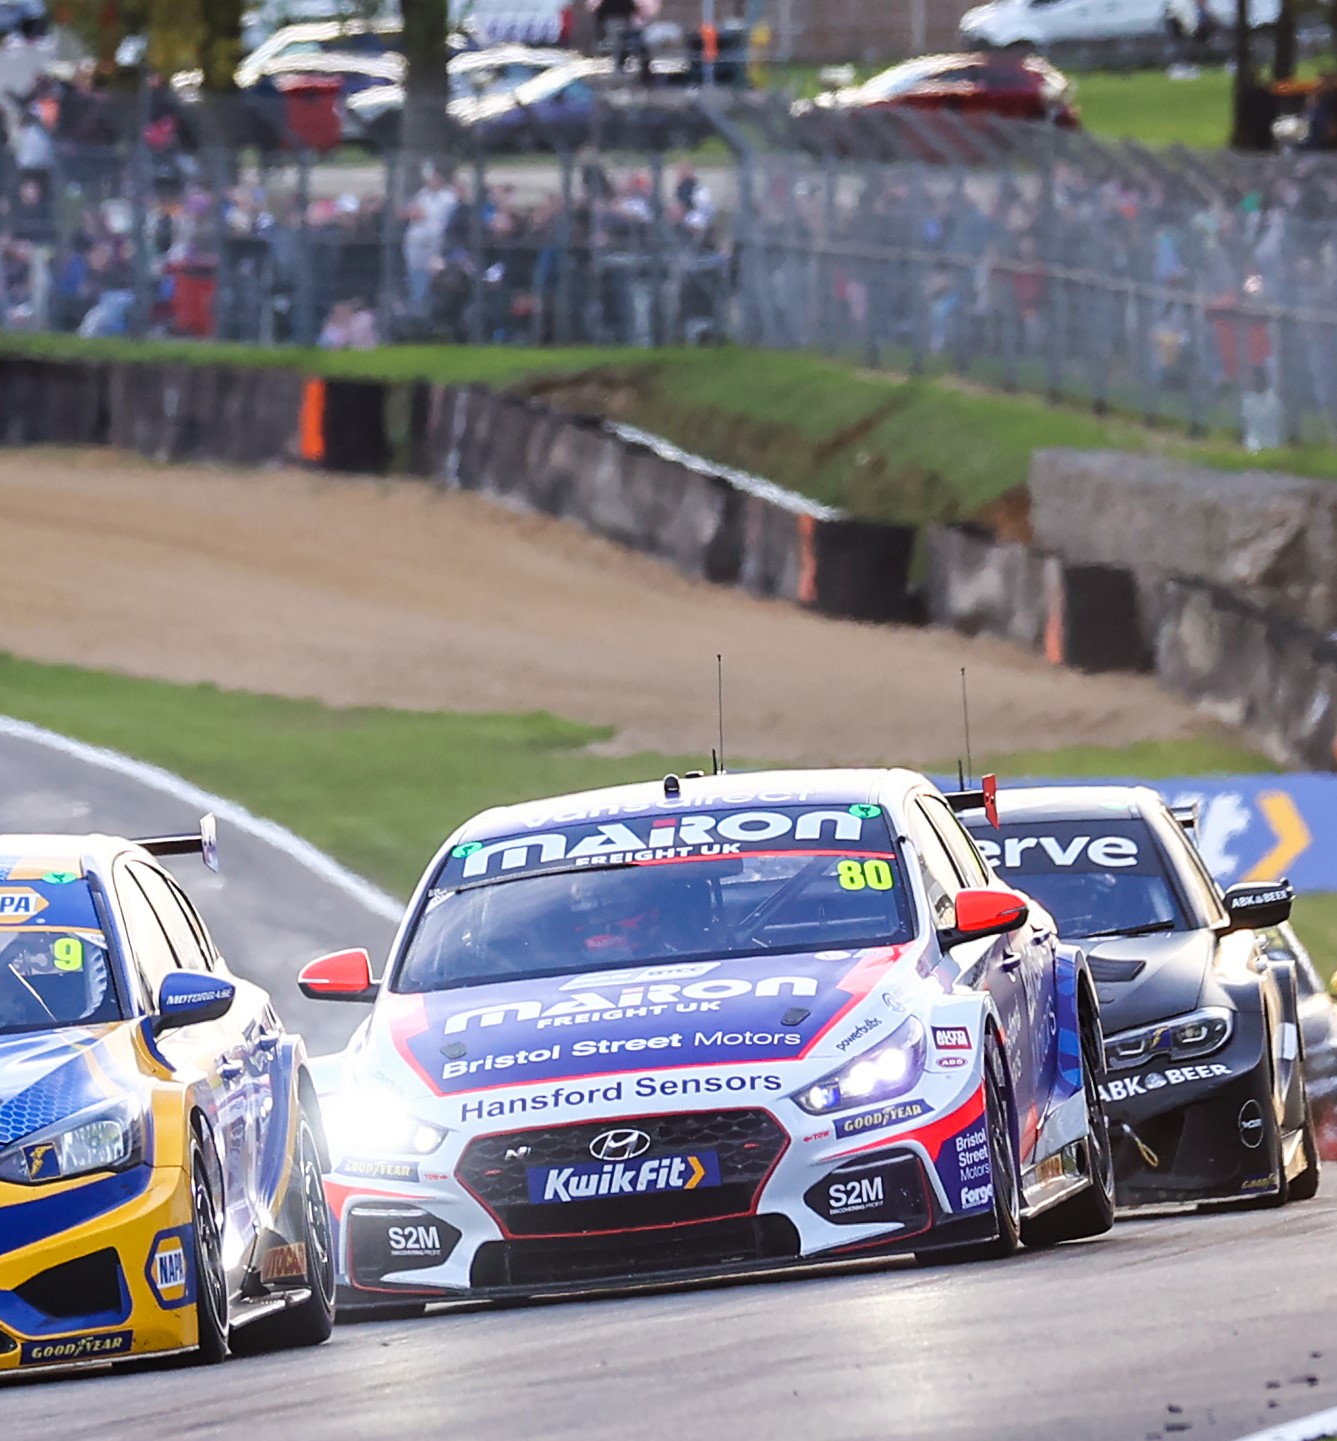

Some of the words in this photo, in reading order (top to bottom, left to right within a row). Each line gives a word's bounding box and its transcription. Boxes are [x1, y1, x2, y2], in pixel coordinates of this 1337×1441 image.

[575, 847, 693, 866] FREIGHT
[701, 842, 741, 855] UK
[837, 860, 893, 890] 80
[53, 938, 83, 971] 9
[537, 1005, 668, 1030] FREIGHT
[676, 1000, 722, 1013] UK
[442, 1045, 561, 1080] Bristol
[572, 1034, 683, 1057] Street
[694, 1031, 802, 1047] Motors
[1098, 1075, 1148, 1102] ABK
[1164, 1063, 1233, 1085] BEER
[461, 1081, 623, 1123] Hansford
[634, 1073, 783, 1098] Sensors
[844, 1105, 923, 1131] GOODYEAR
[956, 1128, 986, 1151] Bristol
[958, 1146, 989, 1167] Street
[960, 1163, 990, 1181] Motors
[829, 1176, 884, 1208] S2M
[388, 1226, 441, 1250] S2M
[31, 1337, 123, 1358] GOODYEAR
